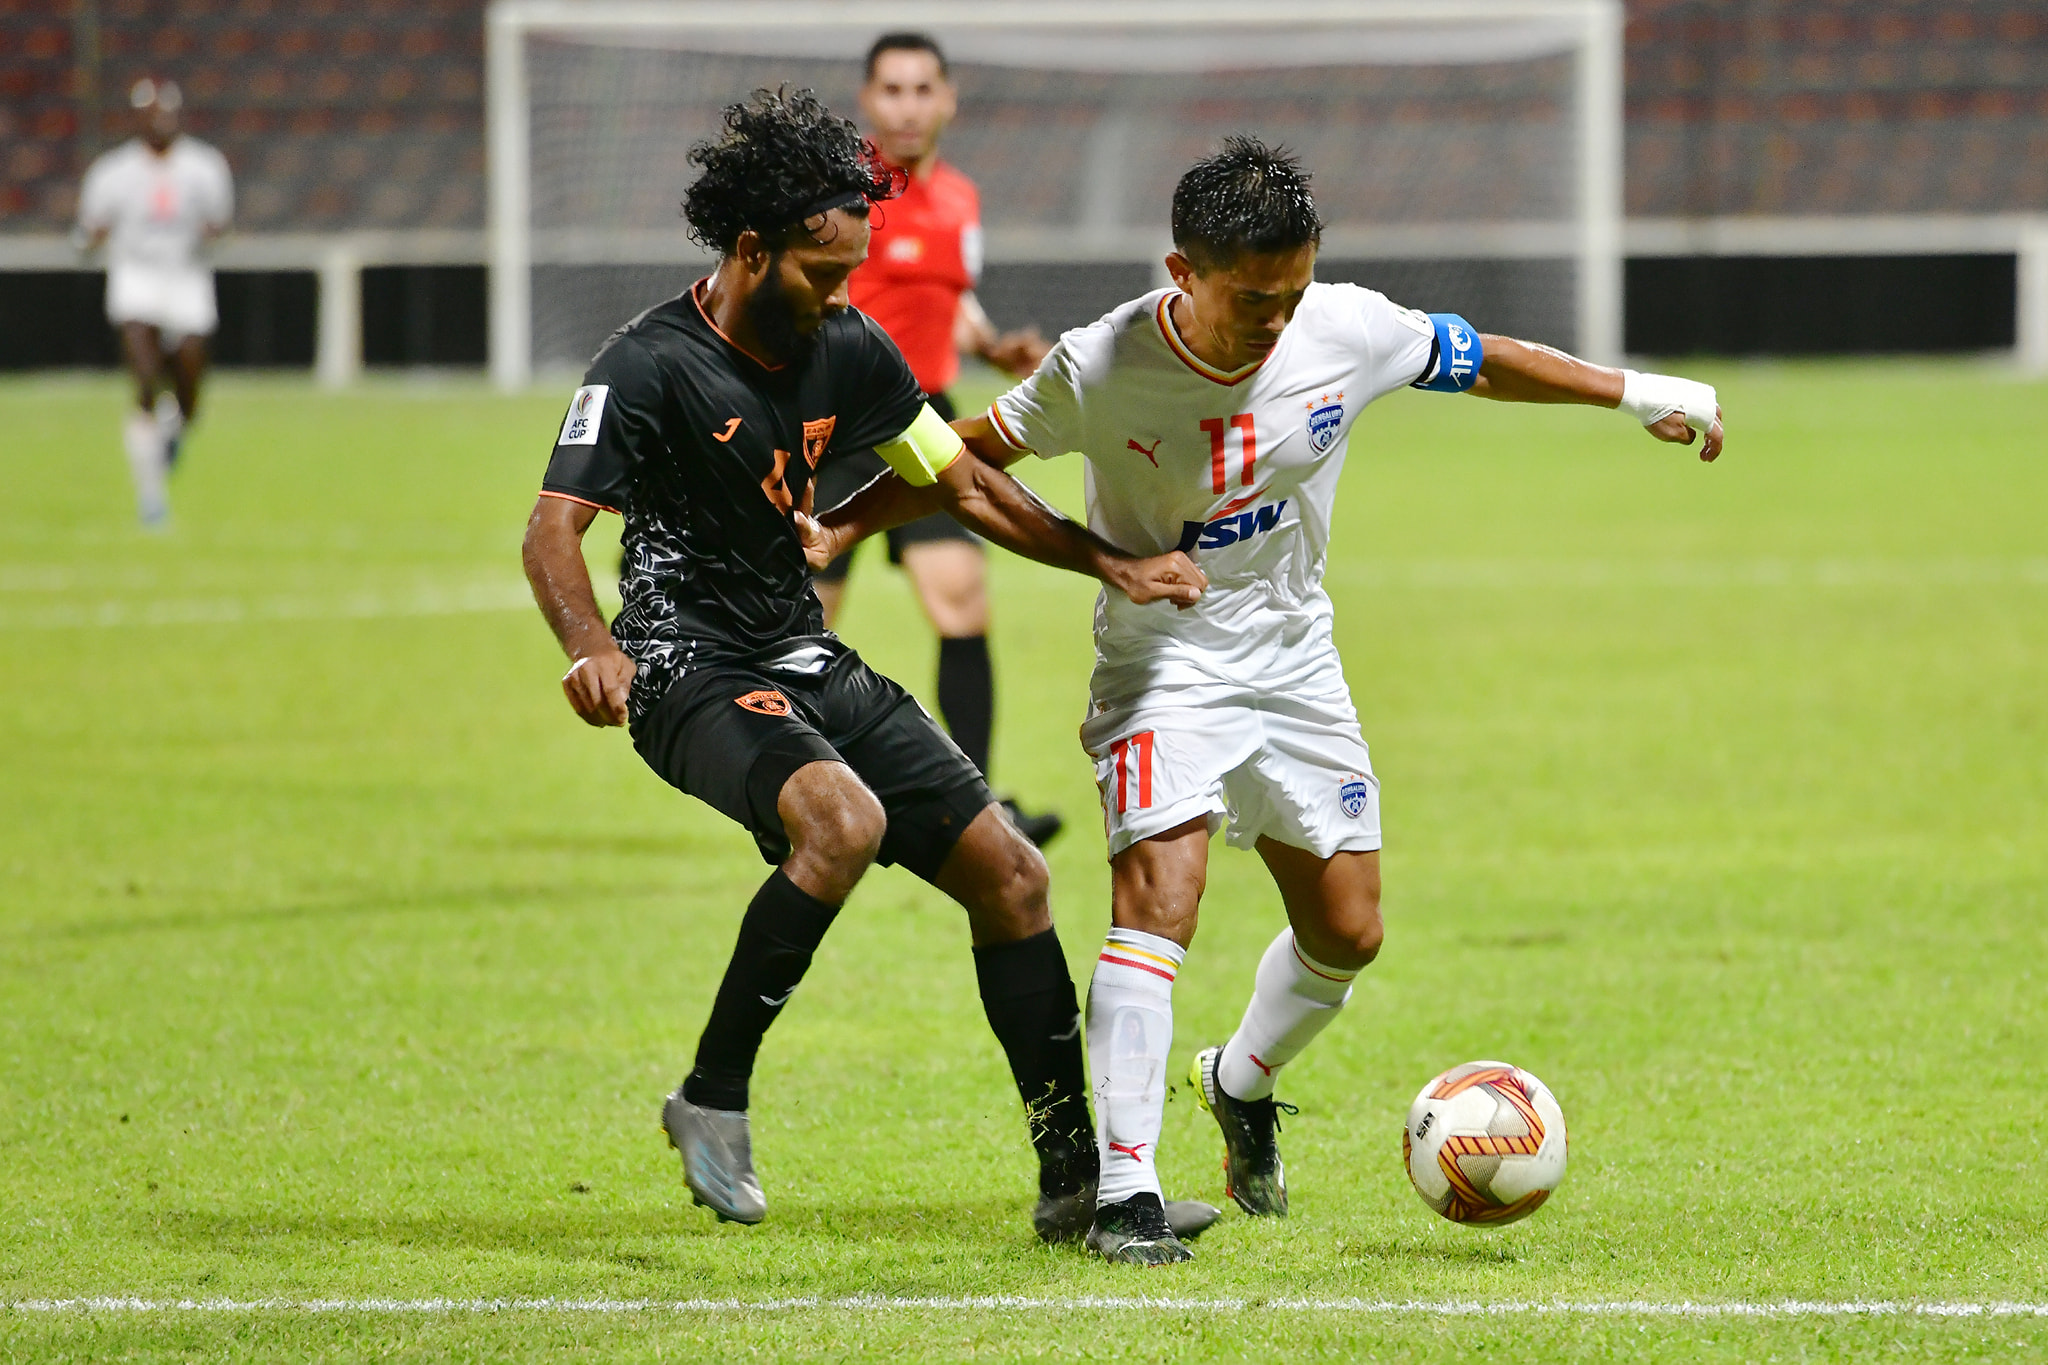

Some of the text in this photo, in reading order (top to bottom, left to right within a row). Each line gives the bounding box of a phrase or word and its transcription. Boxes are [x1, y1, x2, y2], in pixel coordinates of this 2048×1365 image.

[1448, 323, 1473, 387] AFC
[568, 429, 587, 439] CUP
[571, 418, 589, 429] AFC
[1199, 412, 1256, 495] 11
[1174, 499, 1288, 553] JSW
[1109, 730, 1154, 815] 11
